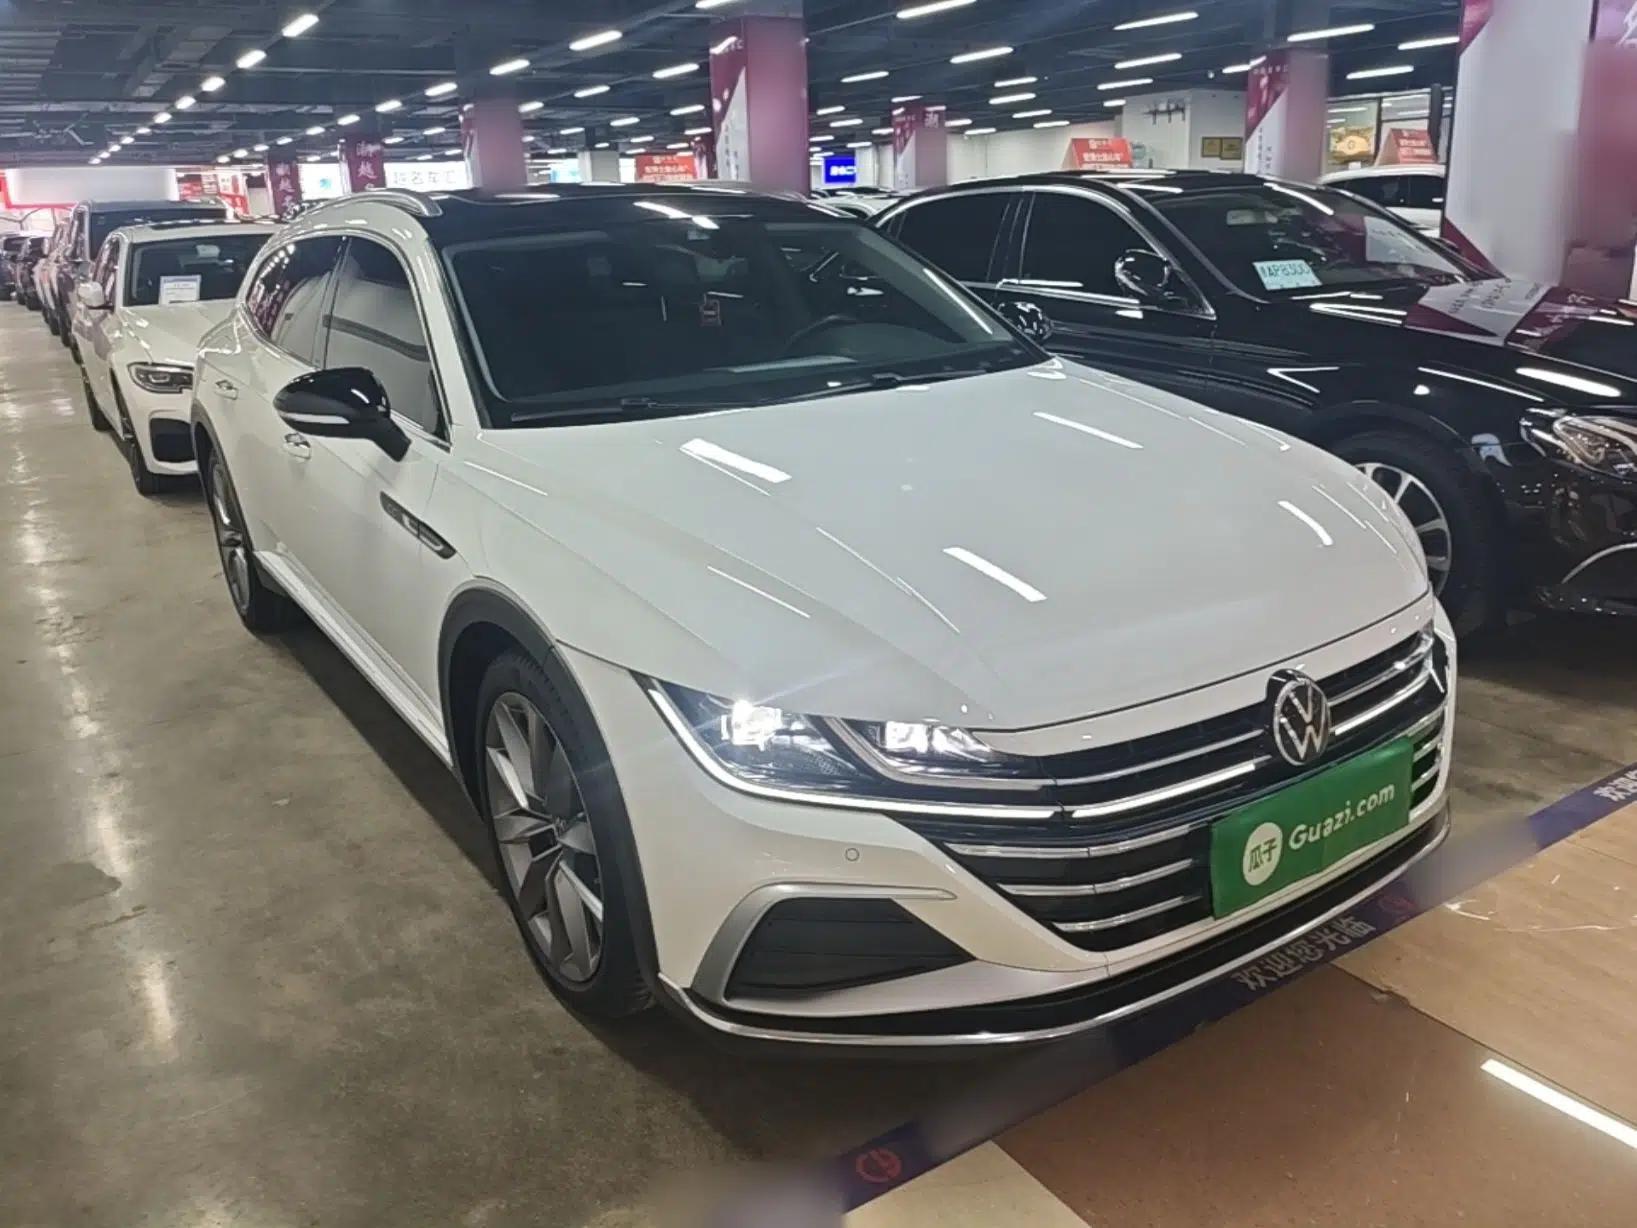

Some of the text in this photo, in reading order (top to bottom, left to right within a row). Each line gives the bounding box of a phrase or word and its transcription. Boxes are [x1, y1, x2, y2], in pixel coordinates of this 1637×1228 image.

[1288, 784, 1395, 850] Guazi.com
[1248, 837, 1277, 873] 瓜子
[1231, 916, 1377, 991] 欢迎您光临
